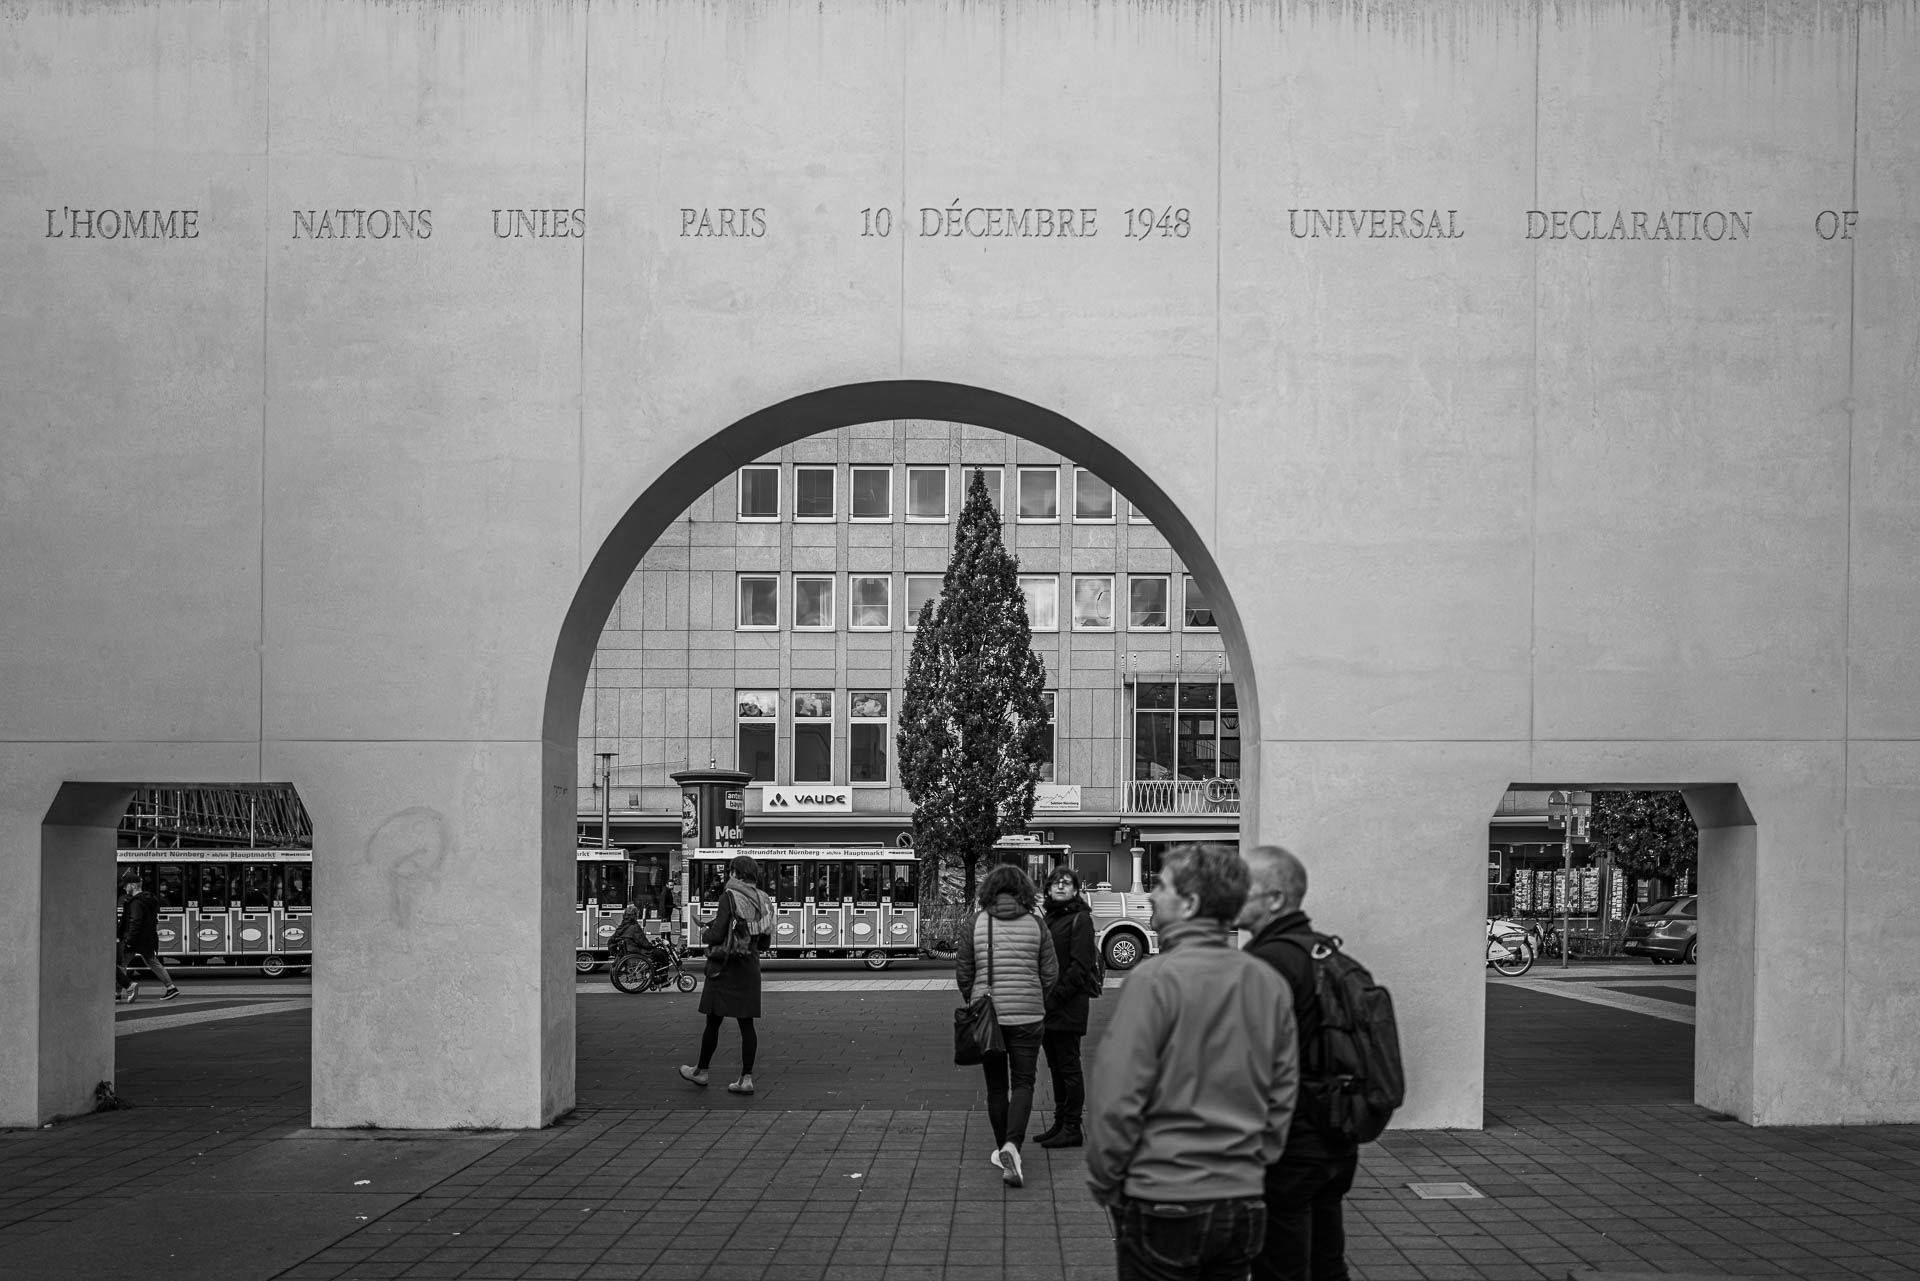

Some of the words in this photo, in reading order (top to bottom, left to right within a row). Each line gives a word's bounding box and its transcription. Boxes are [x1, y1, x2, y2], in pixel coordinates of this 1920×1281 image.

[45, 206, 200, 240] L'HOMME
[292, 209, 432, 239] NATIONS
[491, 208, 586, 239] UNIES
[679, 207, 767, 238] PARIS
[860, 207, 892, 238] 10
[919, 197, 1097, 238] DÉCEMBRE
[1123, 205, 1191, 241] 1948
[1288, 209, 1465, 239] UNIVERSAL
[1525, 210, 1753, 241] DECLARATION
[1815, 210, 1859, 240] OF
[794, 794, 847, 805] VAUDE
[788, 849, 820, 857] Nürnberg
